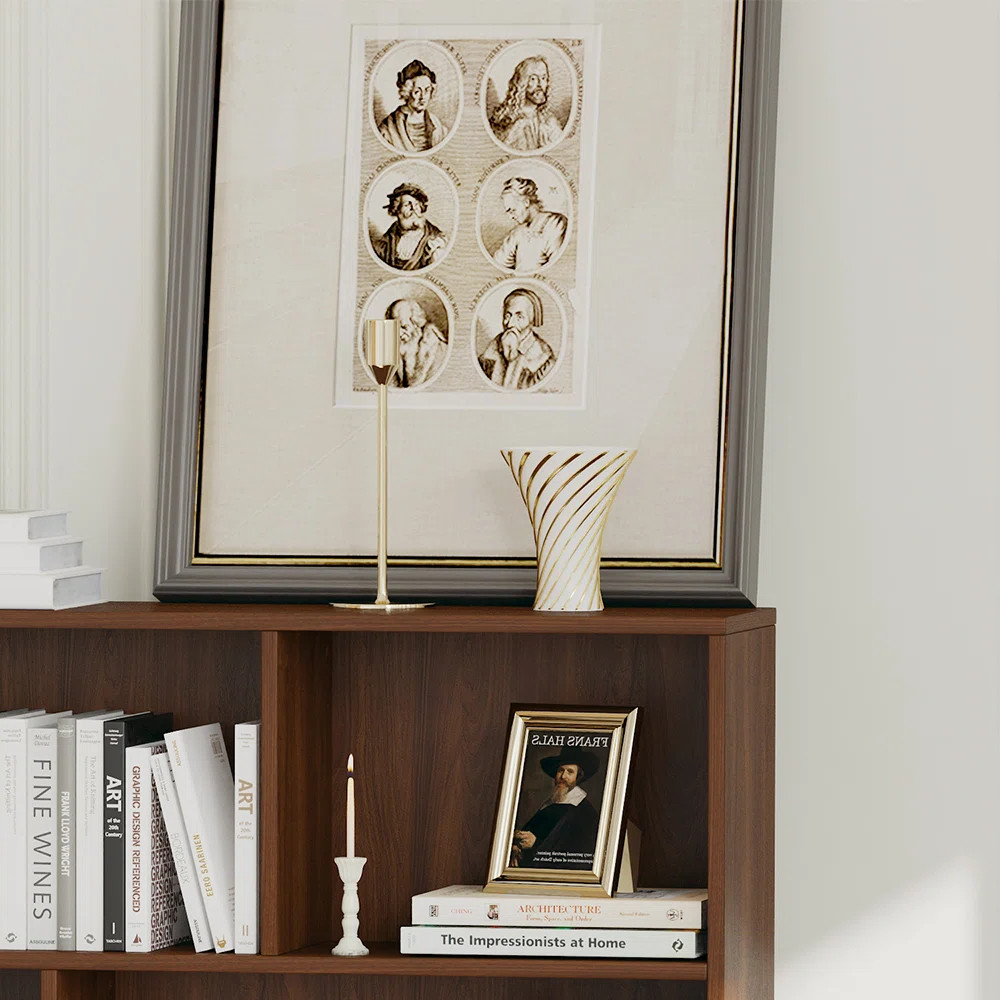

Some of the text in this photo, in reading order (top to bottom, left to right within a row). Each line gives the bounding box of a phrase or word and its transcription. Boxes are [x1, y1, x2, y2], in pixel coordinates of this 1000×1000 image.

[61, 791, 70, 816] FRANK
[106, 775, 122, 812] ART
[238, 779, 253, 814] ART
[33, 760, 52, 919] FINE WINES
[132, 766, 141, 913] GRAPHIC DESIGN REFERENCED
[61, 844, 70, 876] WRIGHT
[193, 834, 214, 897] EERO SAARINEN
[151, 907, 178, 929] GRAPHIC
[517, 904, 602, 914] ARCHITECTURE
[441, 934, 626, 951] The Impressionists at Home
